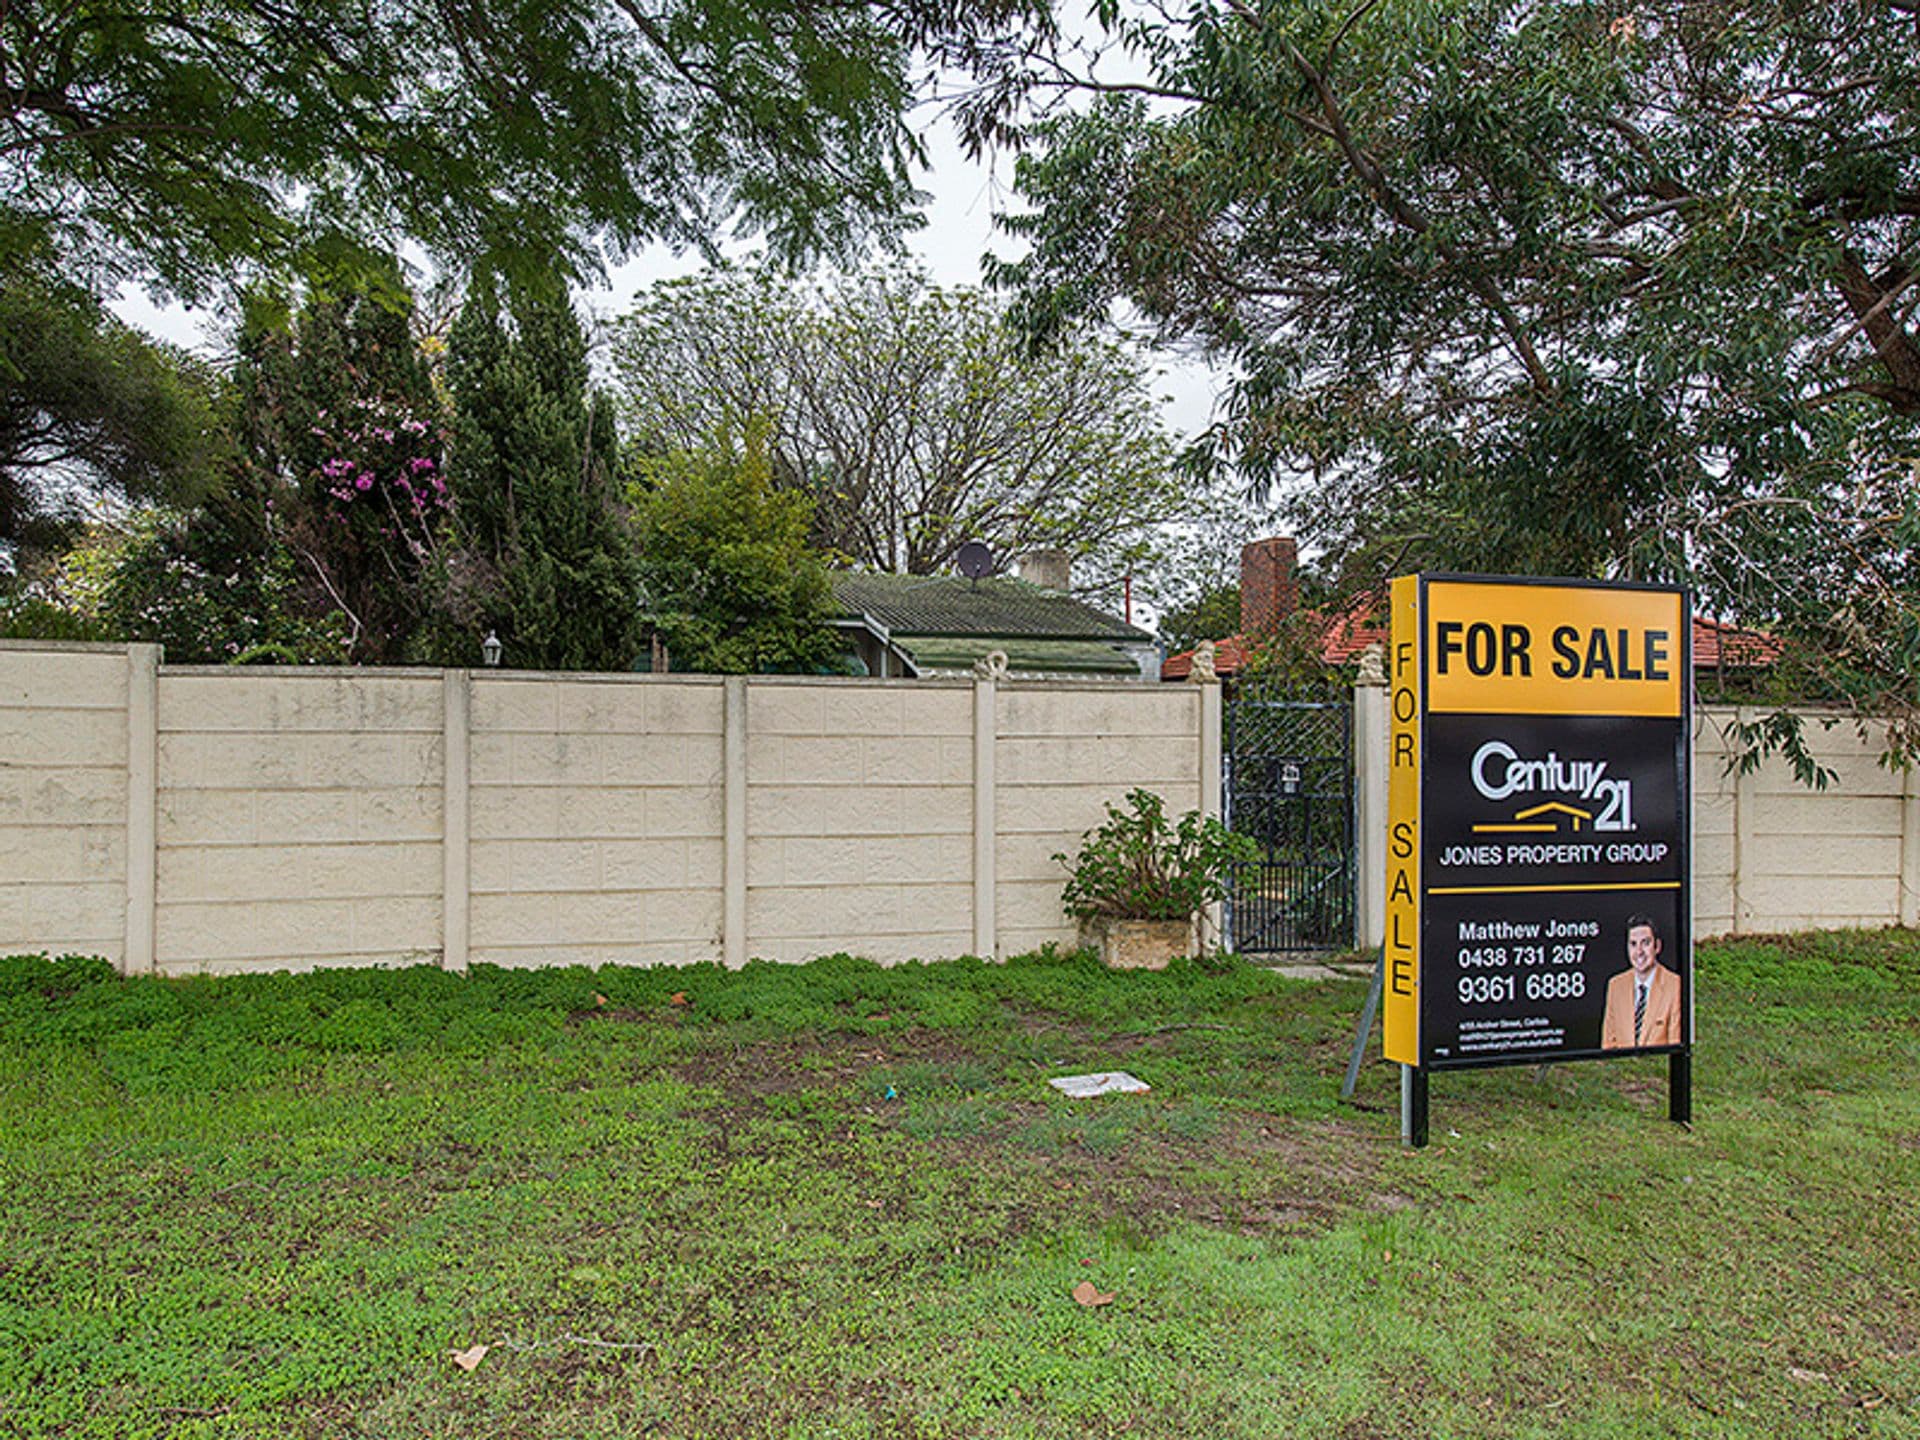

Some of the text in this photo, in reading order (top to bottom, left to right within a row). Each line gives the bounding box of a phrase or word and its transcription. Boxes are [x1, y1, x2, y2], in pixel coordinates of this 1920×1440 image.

[1437, 622, 1669, 680] FOR SALE
[1471, 741, 1607, 800] Century
[1390, 643, 1415, 996] FOR SALE
[1440, 844, 1668, 866] JONES PROPERTY GROUP
[1459, 919, 1600, 940] Matthew Jones
[1458, 945, 1585, 968] 0438 731 267
[1458, 972, 1585, 1003] 9361 6888
